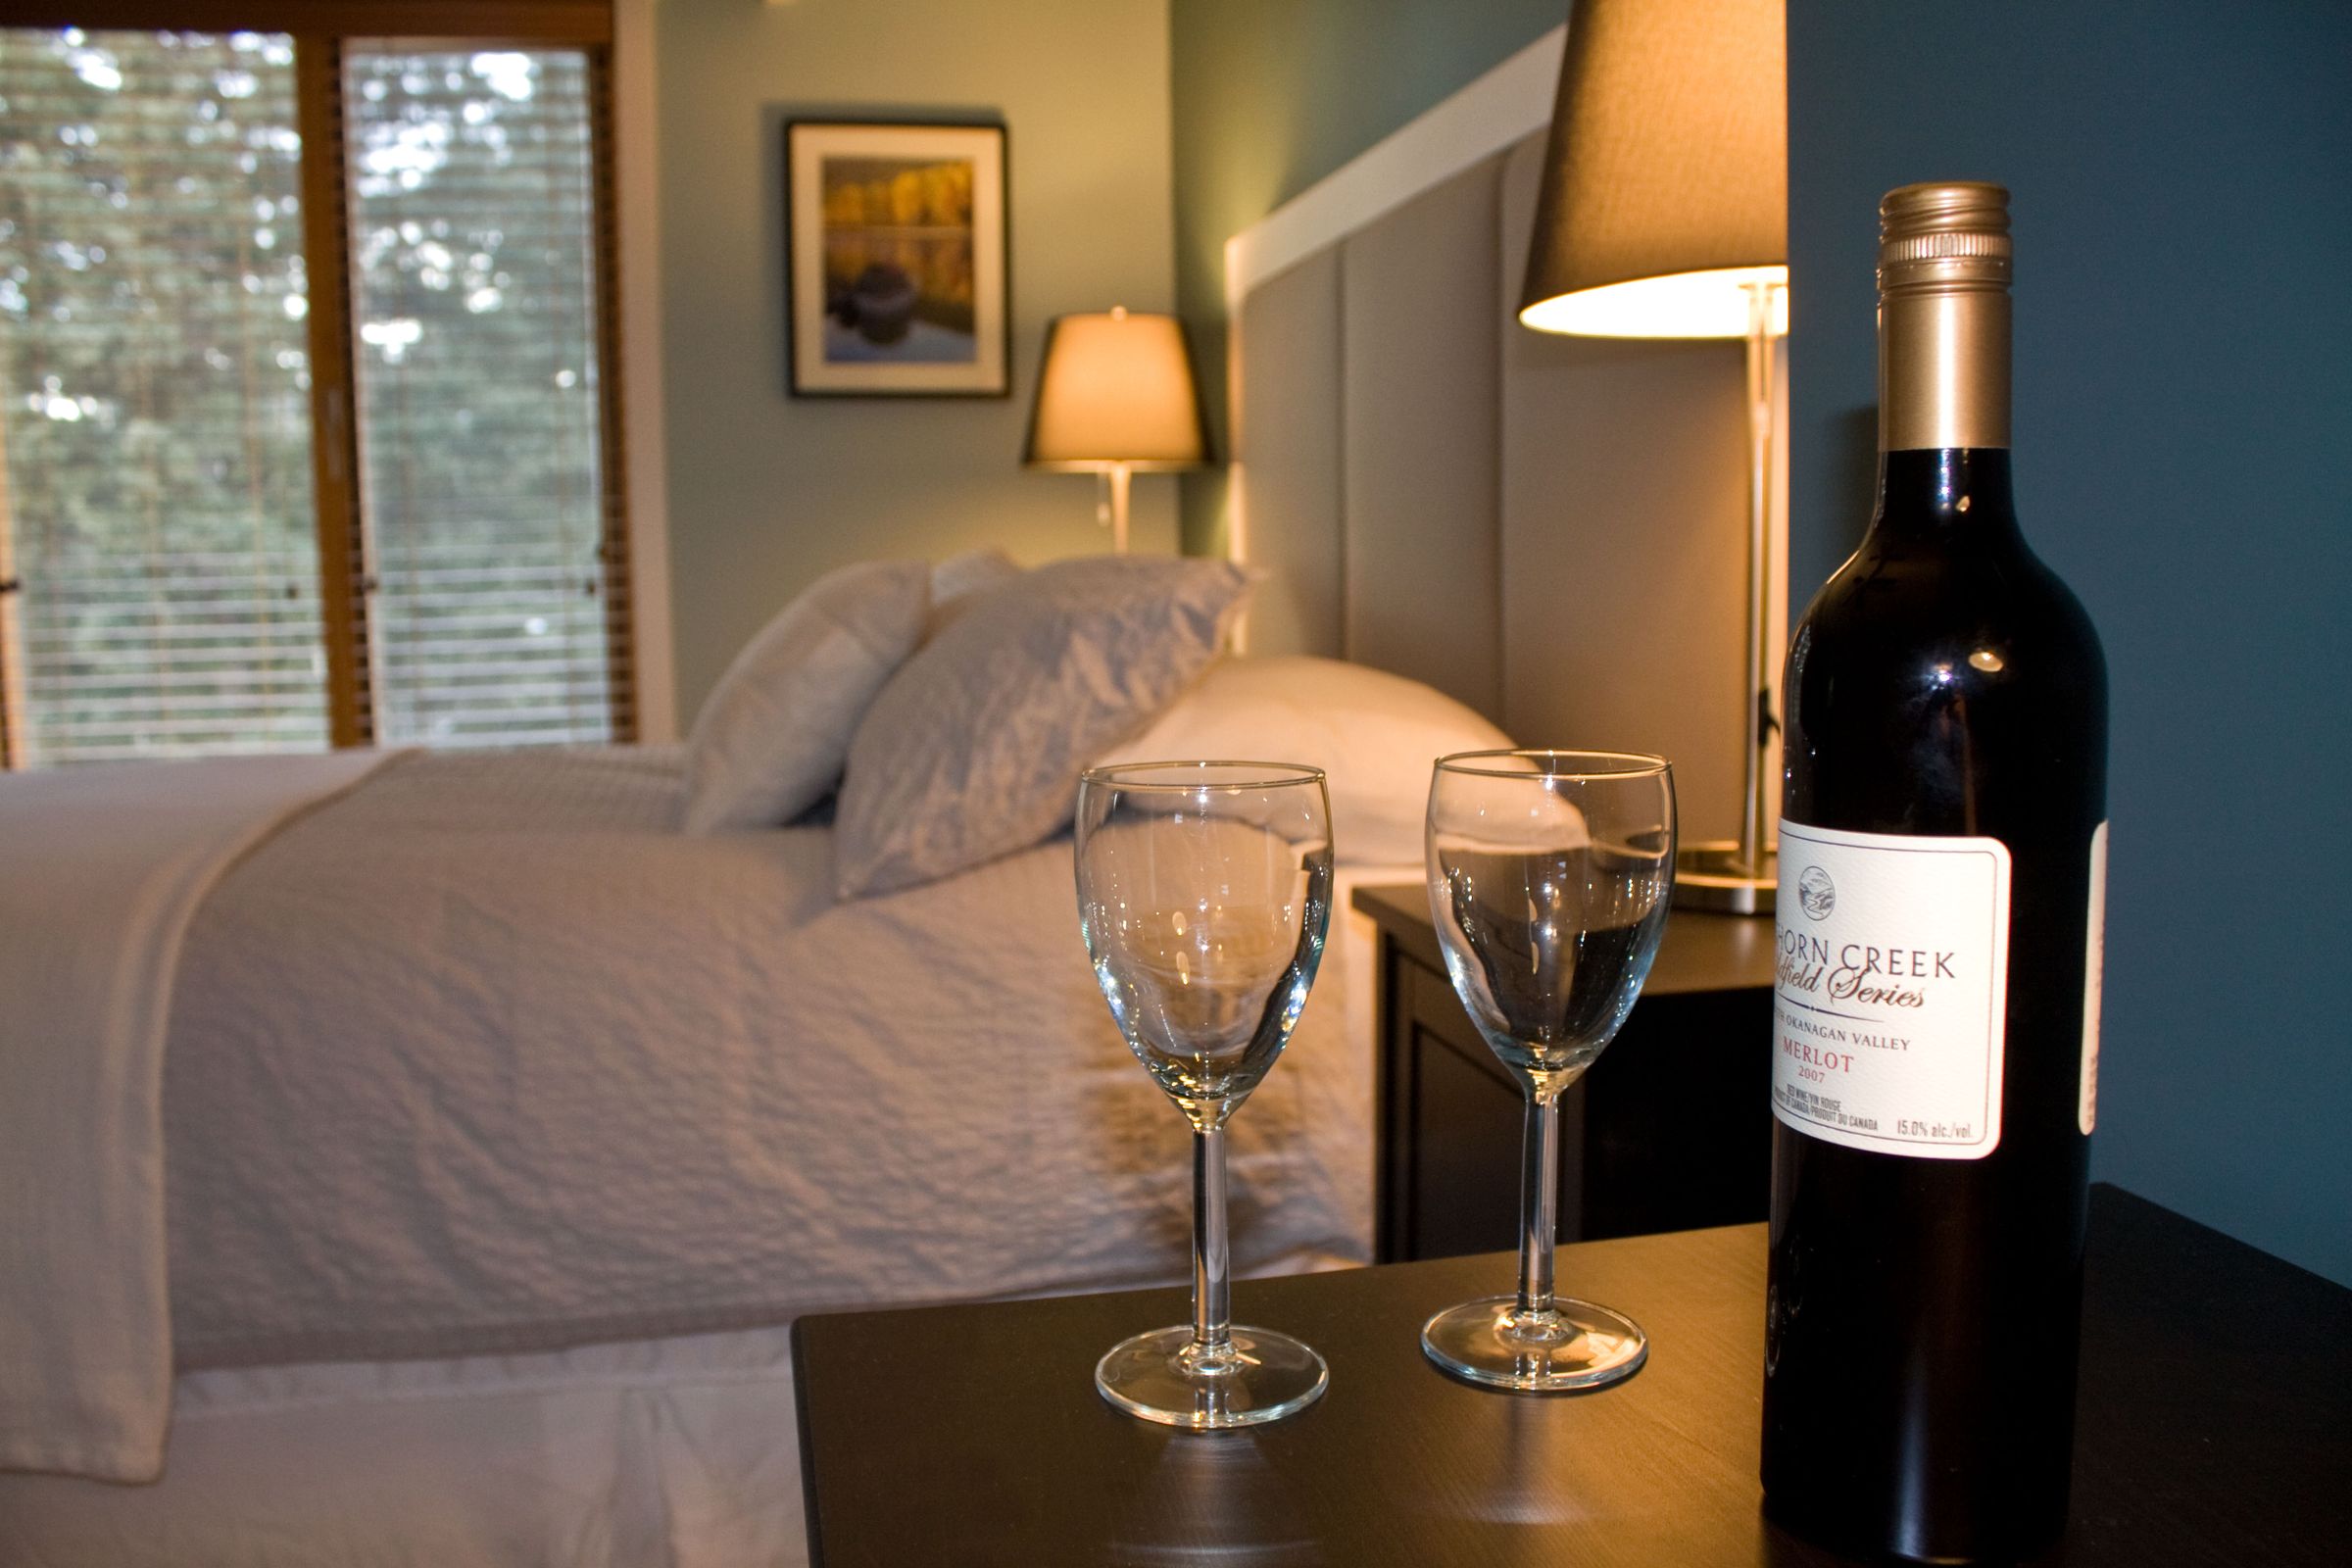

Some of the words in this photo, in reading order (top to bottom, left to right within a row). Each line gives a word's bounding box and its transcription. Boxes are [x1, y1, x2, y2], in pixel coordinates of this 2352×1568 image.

[1841, 944, 1956, 978] CREEK
[1828, 966, 1924, 1007] Series
[1787, 1014, 1845, 1041] OKANAGAN
[1852, 1033, 1910, 1051] VALLEY
[1784, 1036, 1854, 1072] MERLOT
[1798, 1065, 1825, 1083] 2007
[1849, 1115, 1878, 1130] CANADA
[1897, 1119, 1928, 1137] 15.0%
